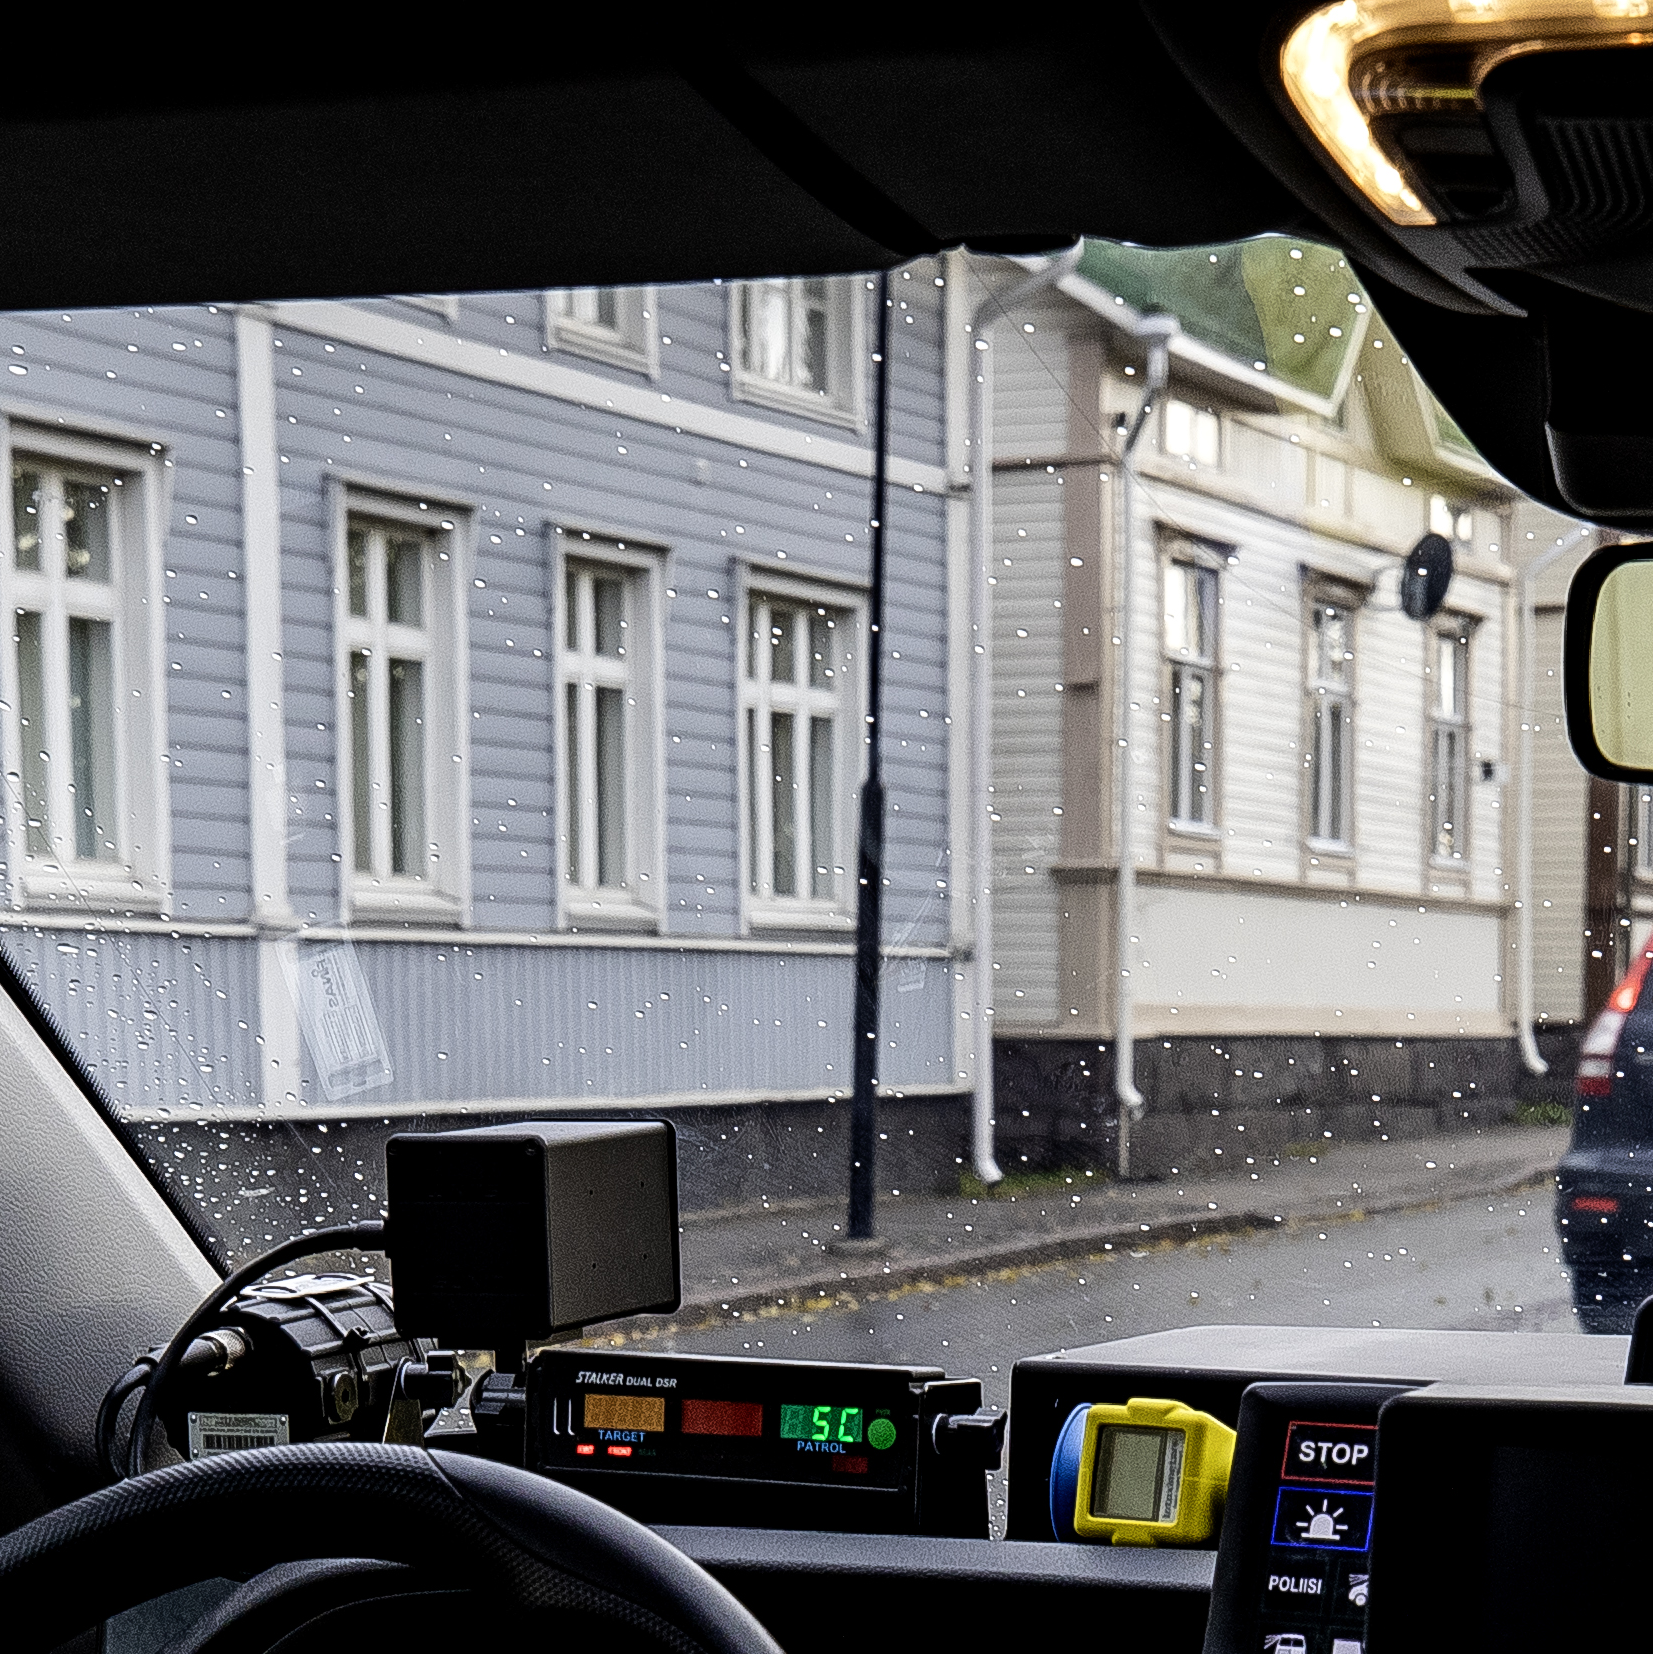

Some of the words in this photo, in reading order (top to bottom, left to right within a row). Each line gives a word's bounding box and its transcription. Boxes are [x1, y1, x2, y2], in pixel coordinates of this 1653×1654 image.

[575, 1371, 624, 1385] STALKER
[625, 1376, 653, 1388] DUAL
[655, 1378, 678, 1388] DSR
[597, 1430, 646, 1443] TARGET
[796, 1440, 846, 1454] PATROL
[1298, 1440, 1369, 1466] STOP
[1268, 1574, 1323, 1595] POLIISI
